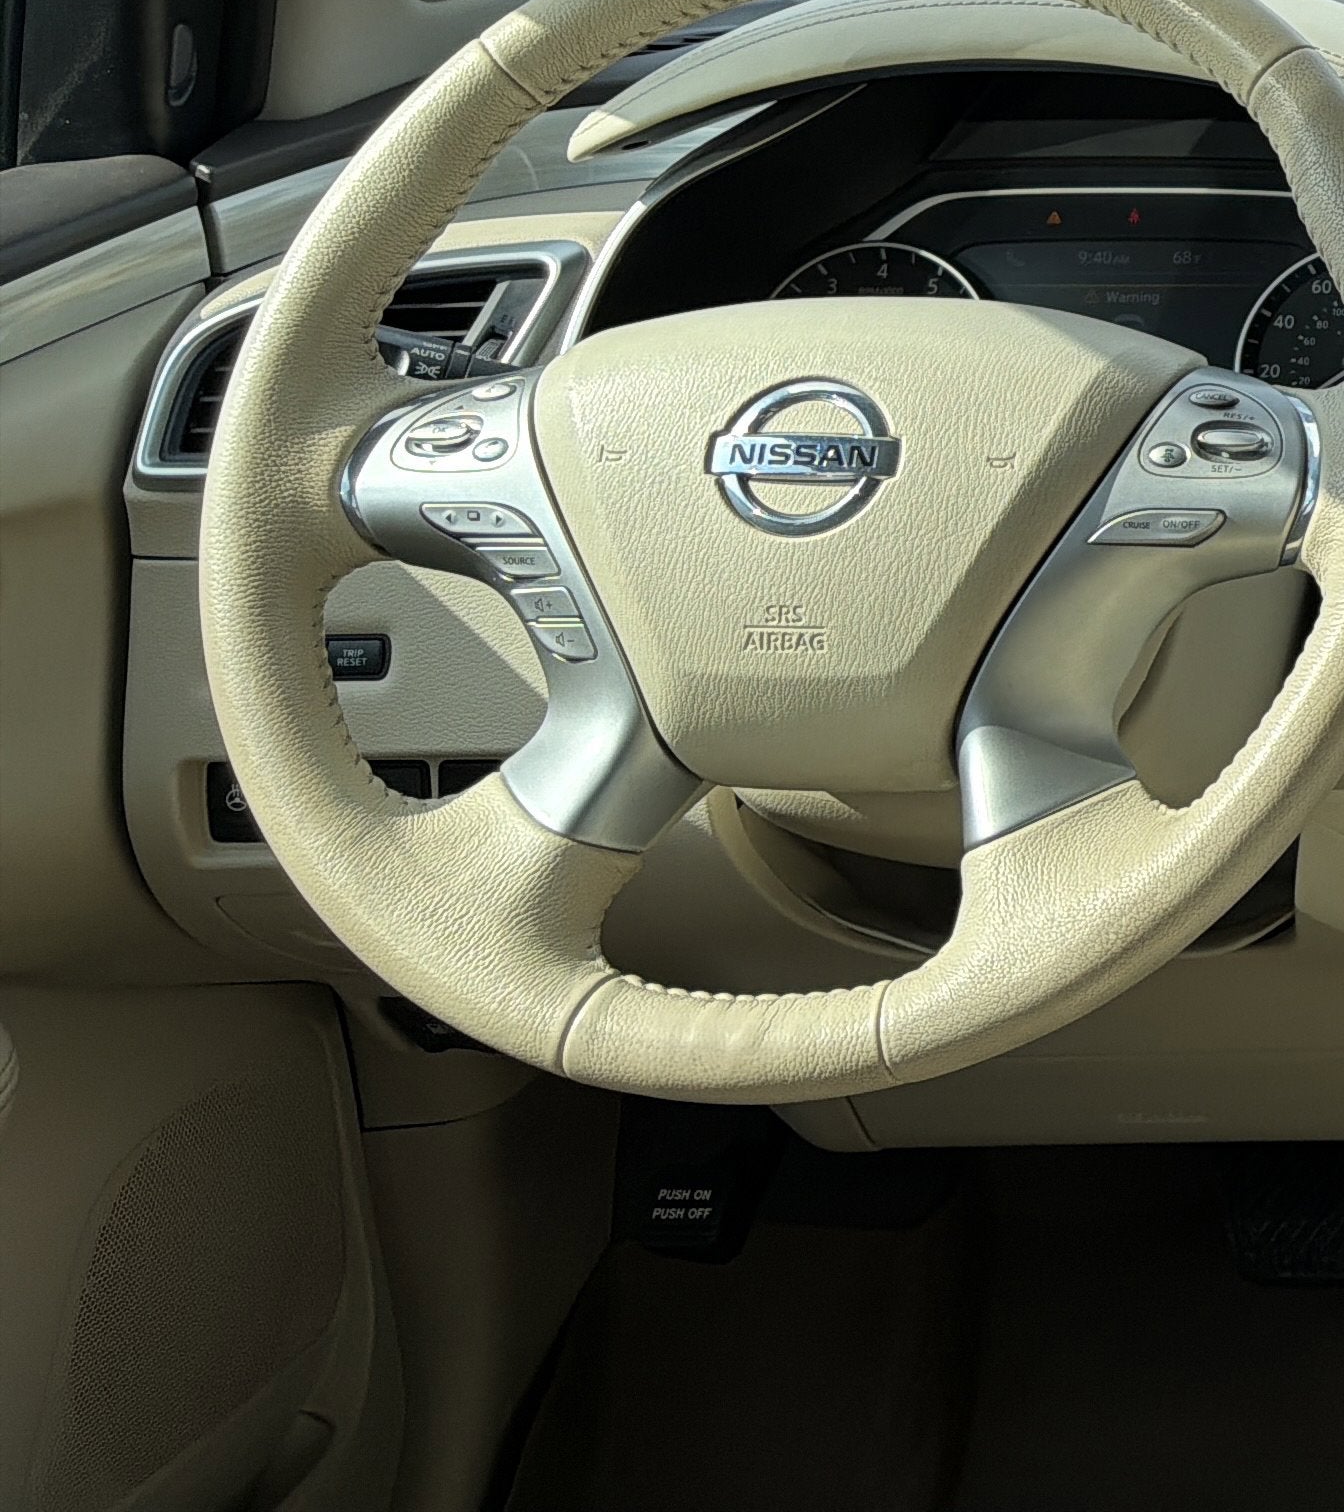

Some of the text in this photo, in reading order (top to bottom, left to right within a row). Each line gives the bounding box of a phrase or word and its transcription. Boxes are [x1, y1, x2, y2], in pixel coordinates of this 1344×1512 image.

[876, 263, 889, 279] 4
[826, 278, 838, 295] 3
[927, 278, 939, 295] 5
[1311, 280, 1332, 295] 60
[1104, 291, 1160, 306] Warning
[1273, 314, 1295, 329] 40
[410, 346, 446, 361] AUTO
[1297, 356, 1310, 366] 40
[1260, 364, 1281, 379] 20
[728, 443, 878, 468] NISSAN
[1122, 519, 1201, 530] CRUISE ON/OFF
[502, 556, 536, 566] SOURCE
[764, 604, 804, 625] SRS
[743, 630, 829, 653] AIRBAG
[342, 648, 364, 658] TRIP
[336, 657, 368, 667] RESET
[657, 1188, 712, 1201] PUSH ON
[651, 1207, 713, 1220] PUSH OFF
